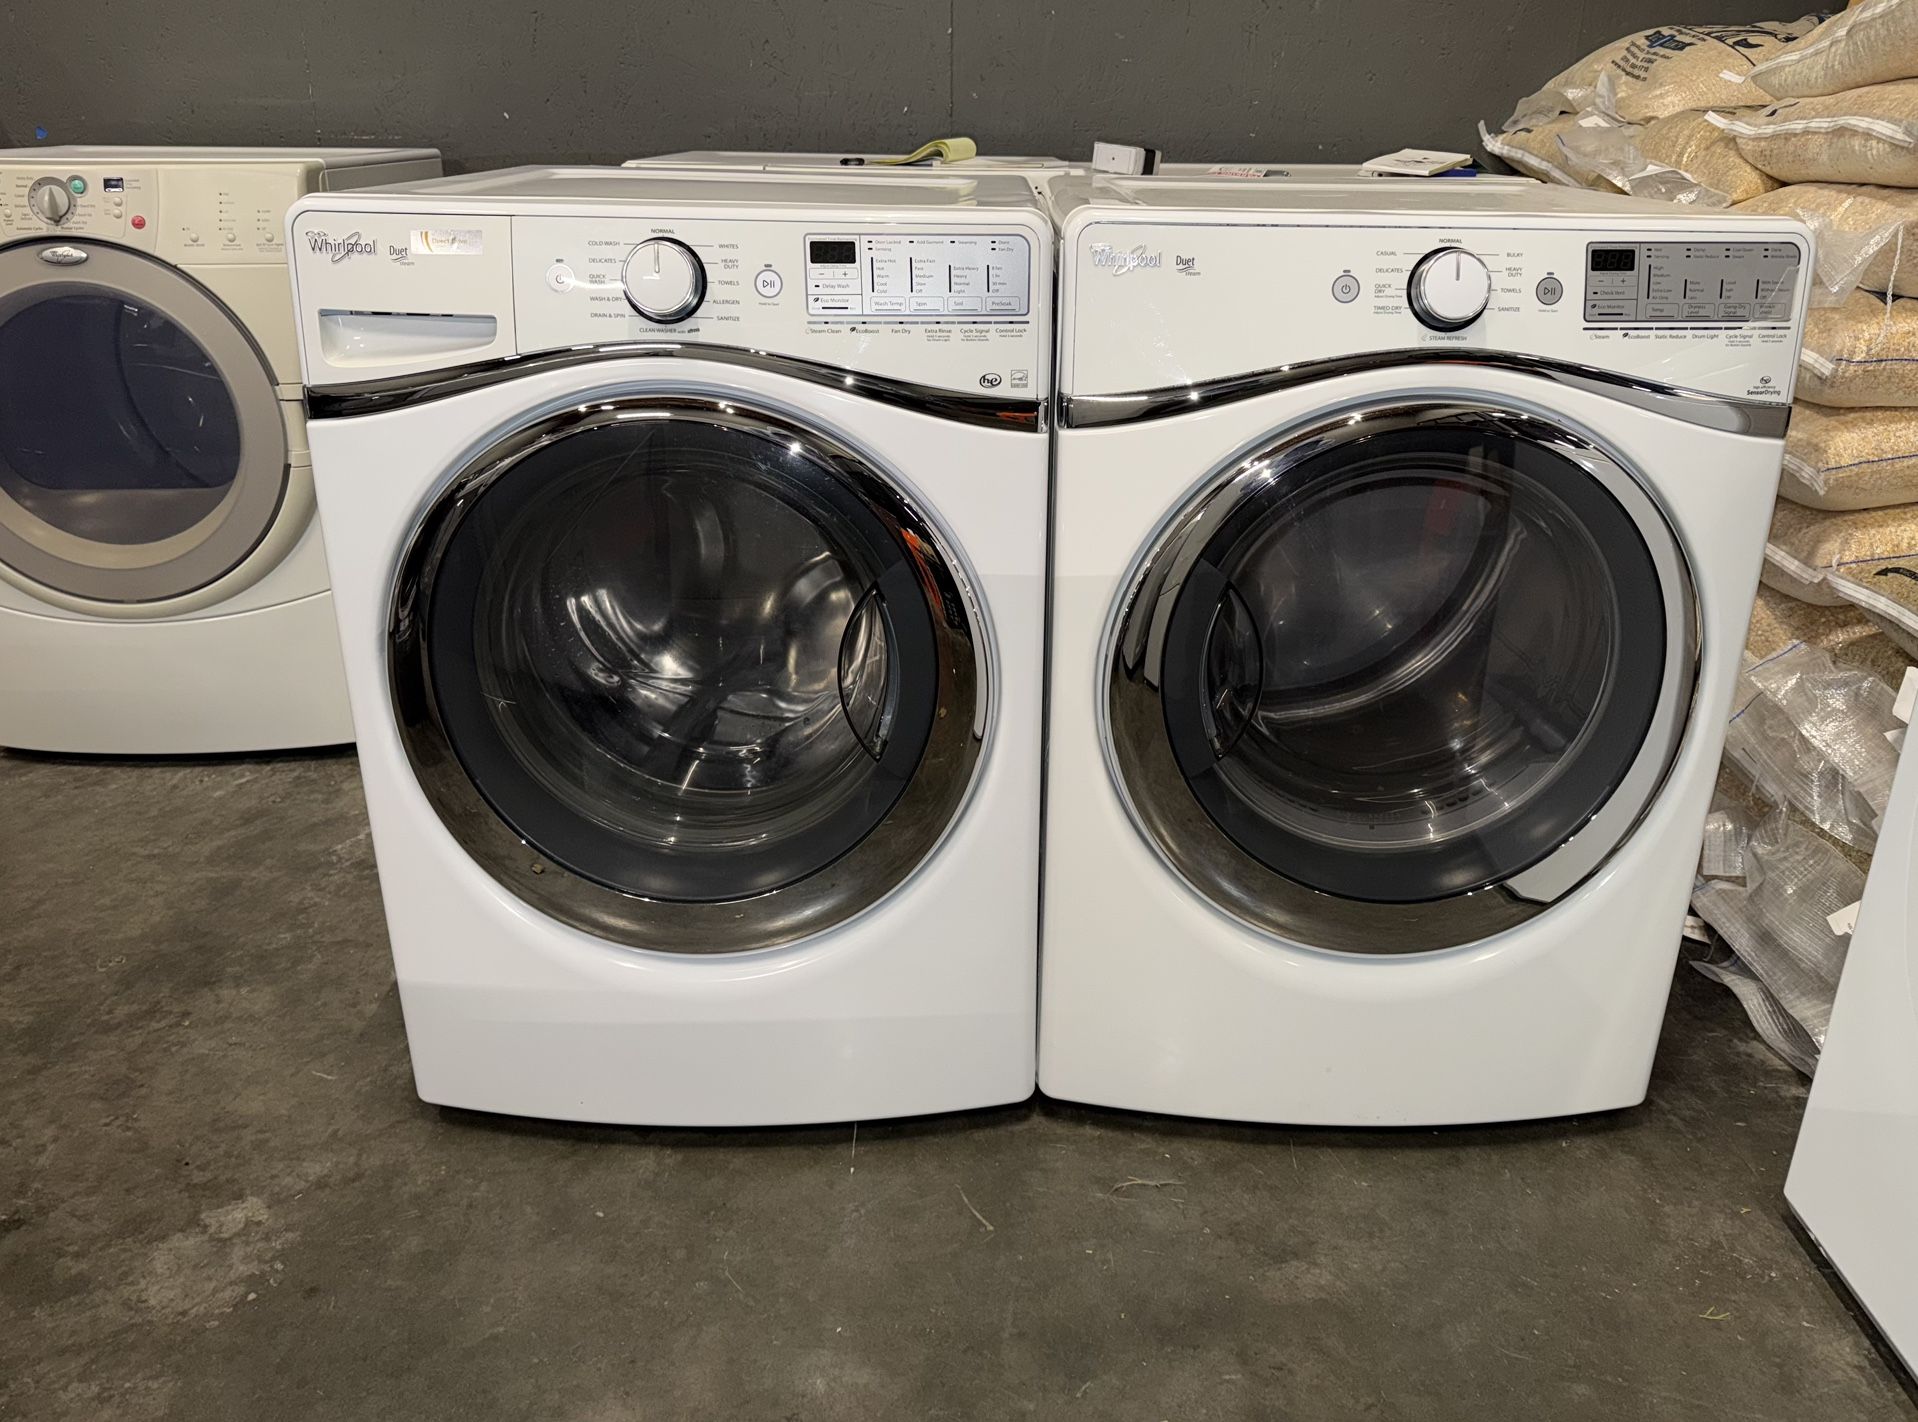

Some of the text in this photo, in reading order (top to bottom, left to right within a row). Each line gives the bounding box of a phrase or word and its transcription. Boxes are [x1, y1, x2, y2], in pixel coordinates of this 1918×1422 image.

[307, 234, 376, 260] Whirlpool
[390, 246, 408, 256] Duet
[1091, 244, 1162, 273] Whirlpool
[1176, 256, 1195, 266] Duet
[981, 374, 1000, 387] he
